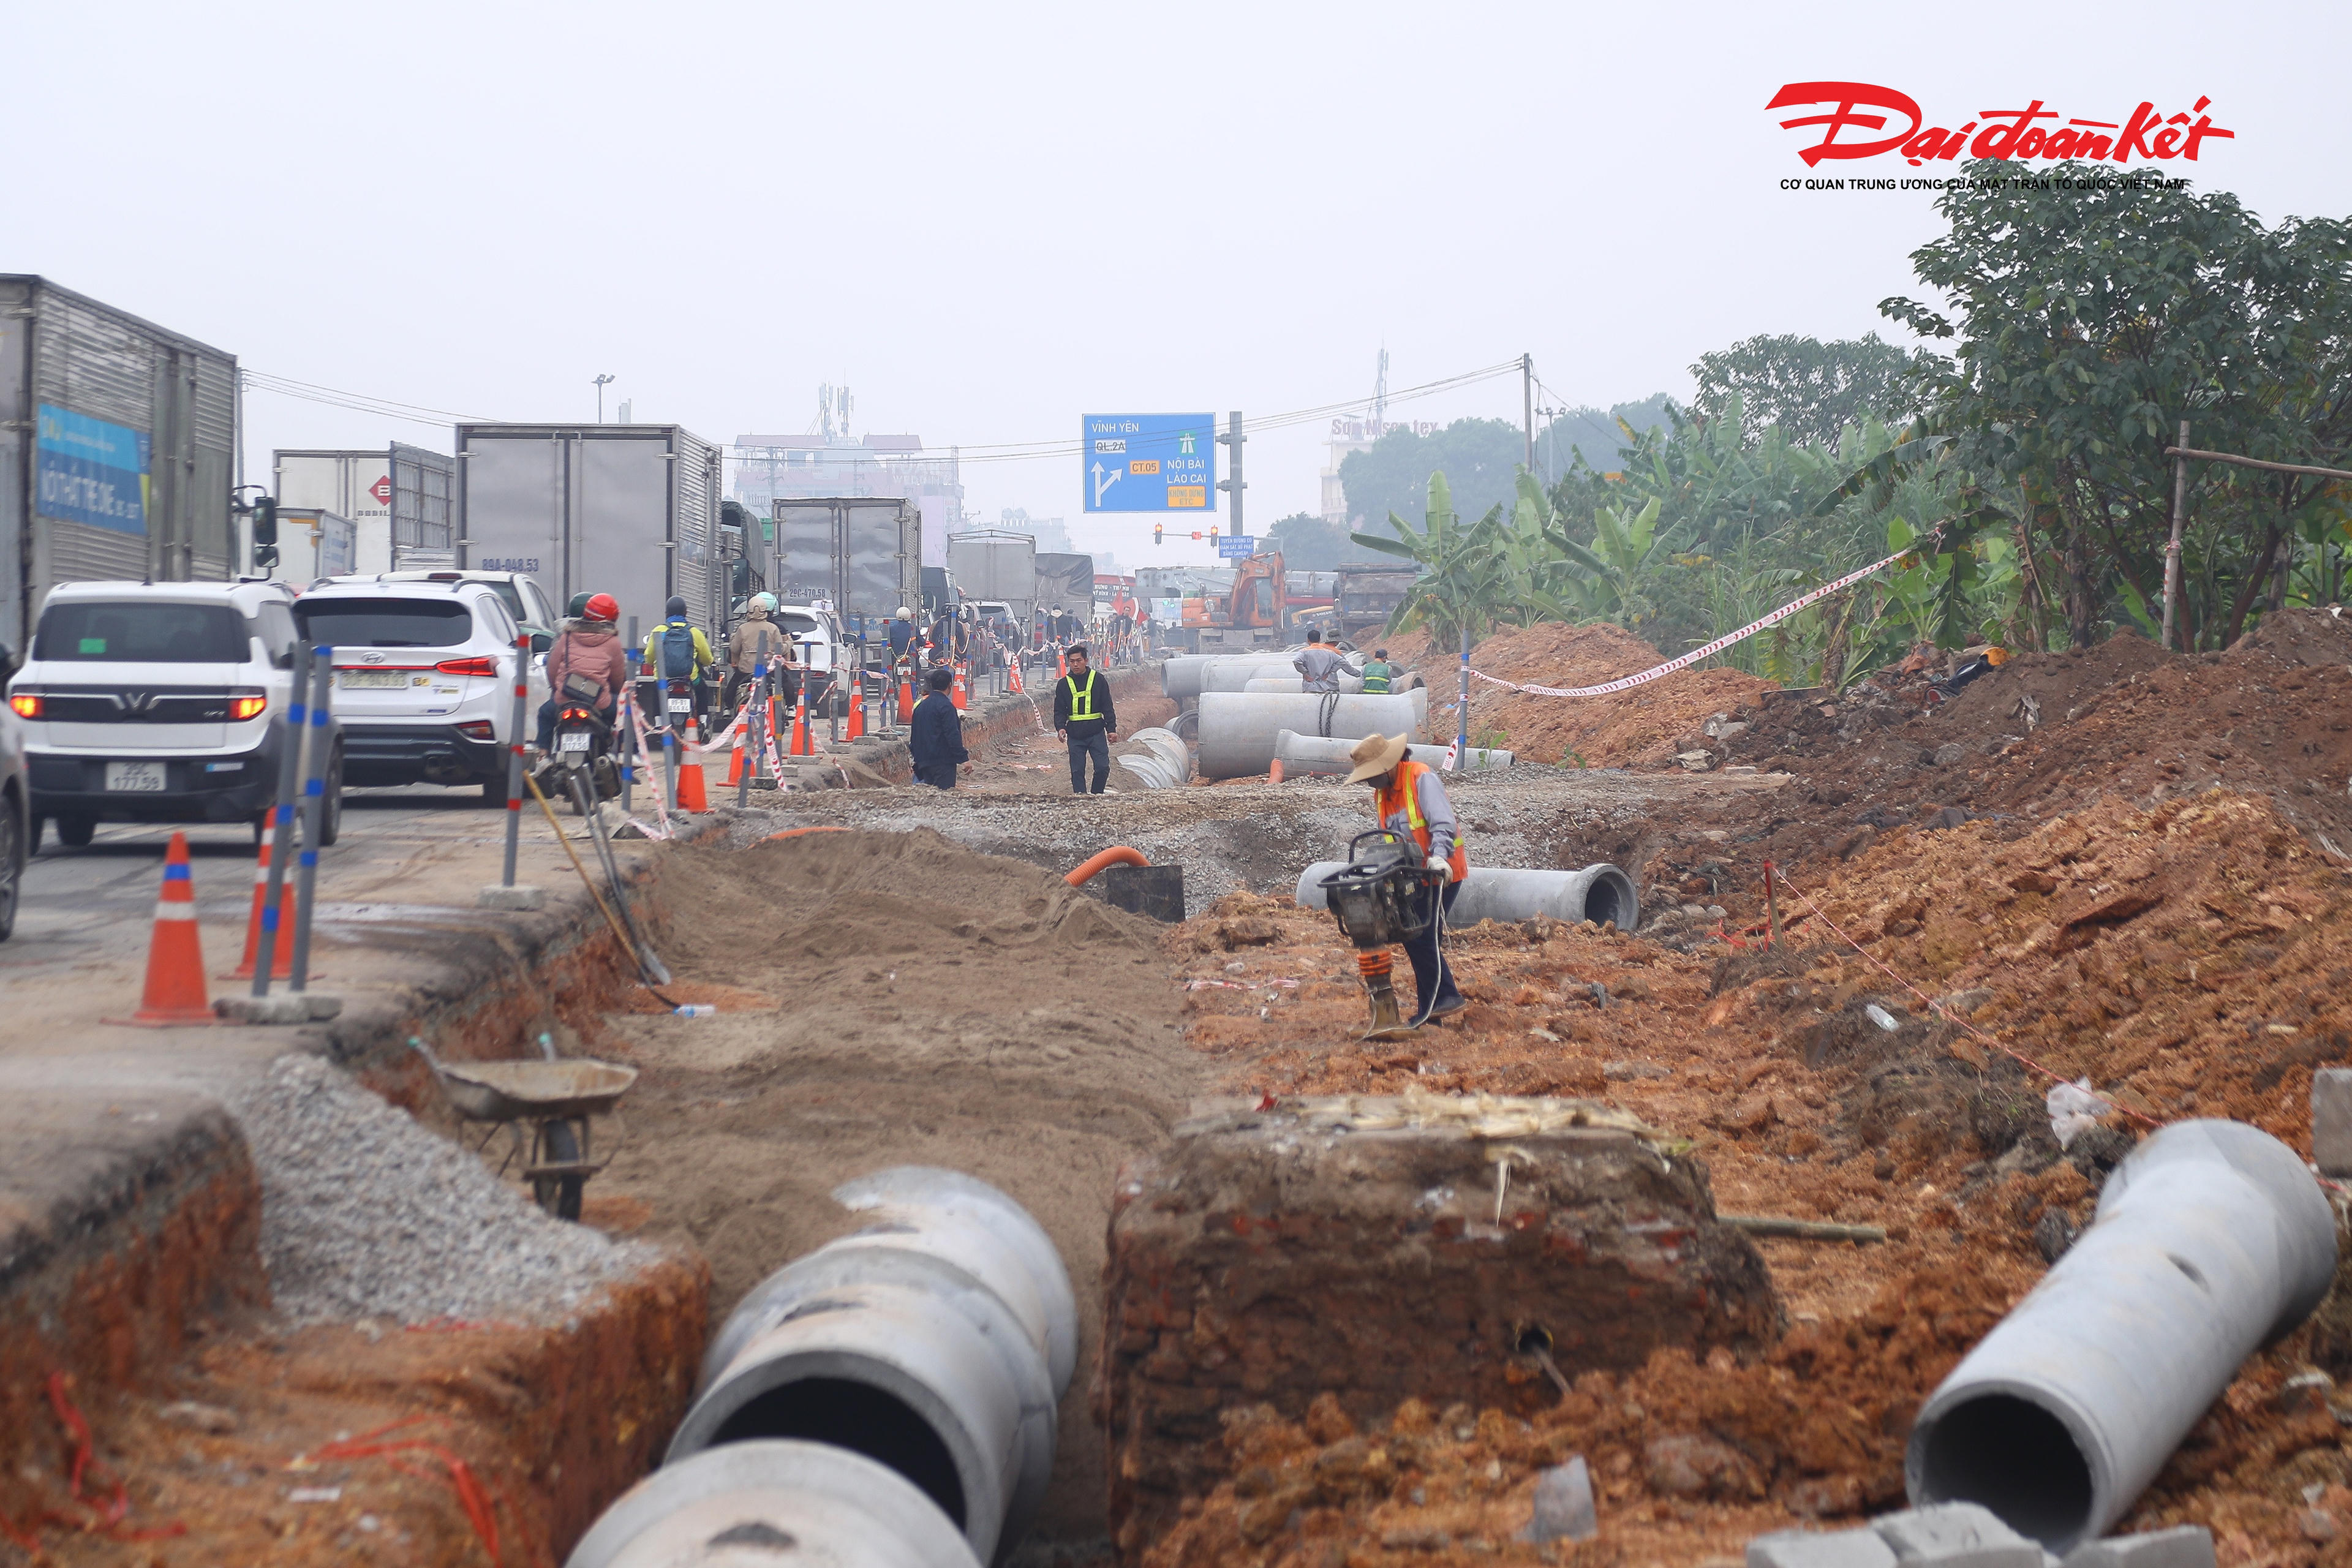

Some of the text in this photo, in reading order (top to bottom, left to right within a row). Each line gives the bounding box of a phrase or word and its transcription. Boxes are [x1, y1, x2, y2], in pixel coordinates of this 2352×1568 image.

[1092, 420, 1140, 432] VĨNH YÊN
[1096, 442, 1126, 451] QL.2A
[1133, 462, 1157, 472] CT.05
[1167, 457, 1205, 472] NỘI BÀI
[1167, 472, 1207, 484] LÀO CAI
